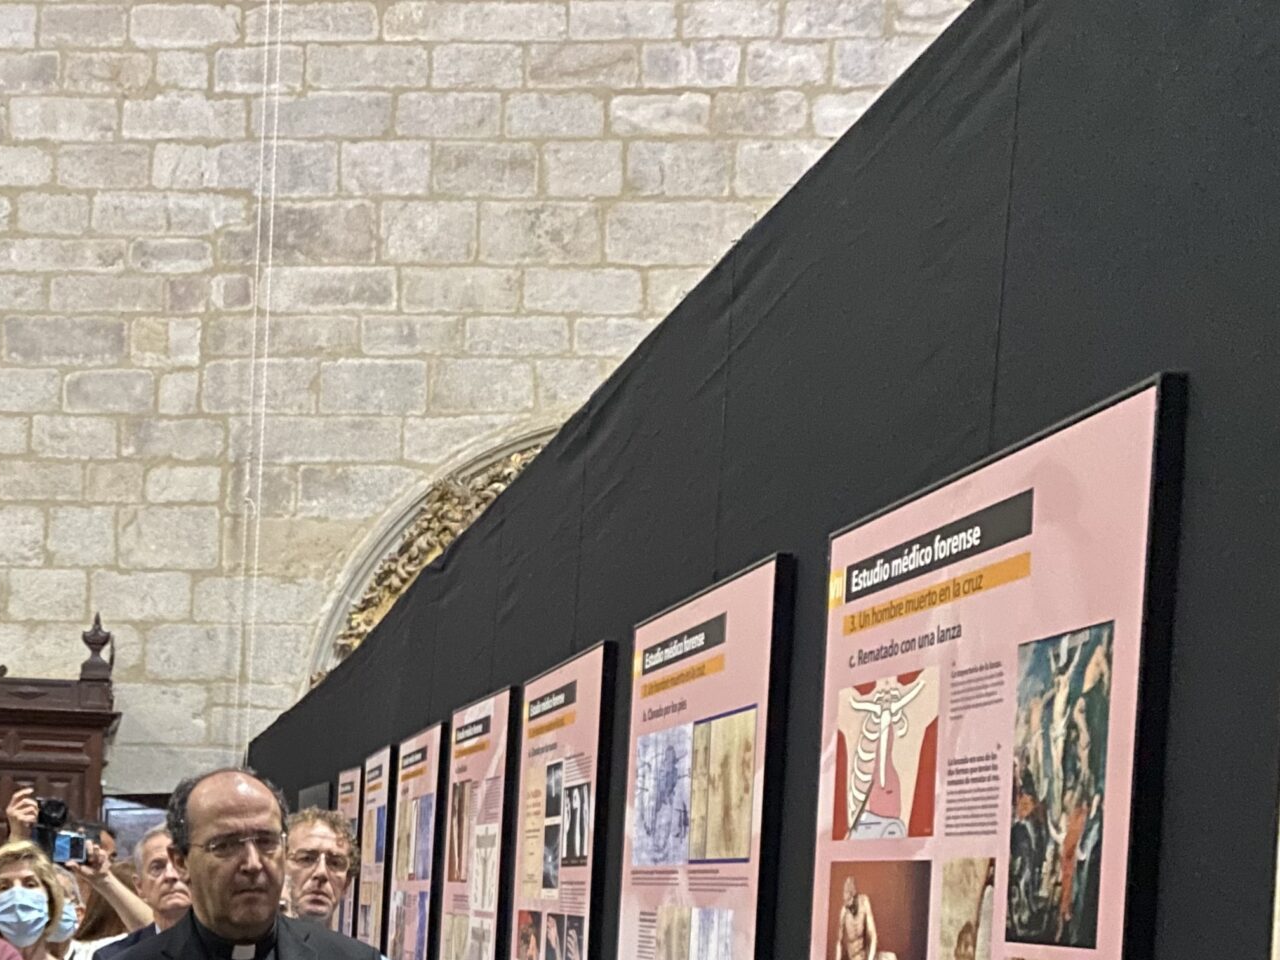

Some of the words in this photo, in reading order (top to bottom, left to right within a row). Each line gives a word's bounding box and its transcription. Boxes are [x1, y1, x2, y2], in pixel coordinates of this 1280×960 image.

[851, 559, 890, 593] Estudio
[891, 543, 932, 578] médico
[934, 526, 981, 562] forense
[859, 610, 870, 629] Un
[871, 600, 904, 626] hombre
[905, 589, 937, 614] muerto
[939, 585, 951, 603] en
[953, 578, 961, 598] la
[962, 574, 984, 595] cruz
[857, 638, 899, 666] Rematado
[900, 638, 916, 655] con
[918, 631, 935, 649] una
[936, 624, 963, 644] lanza
